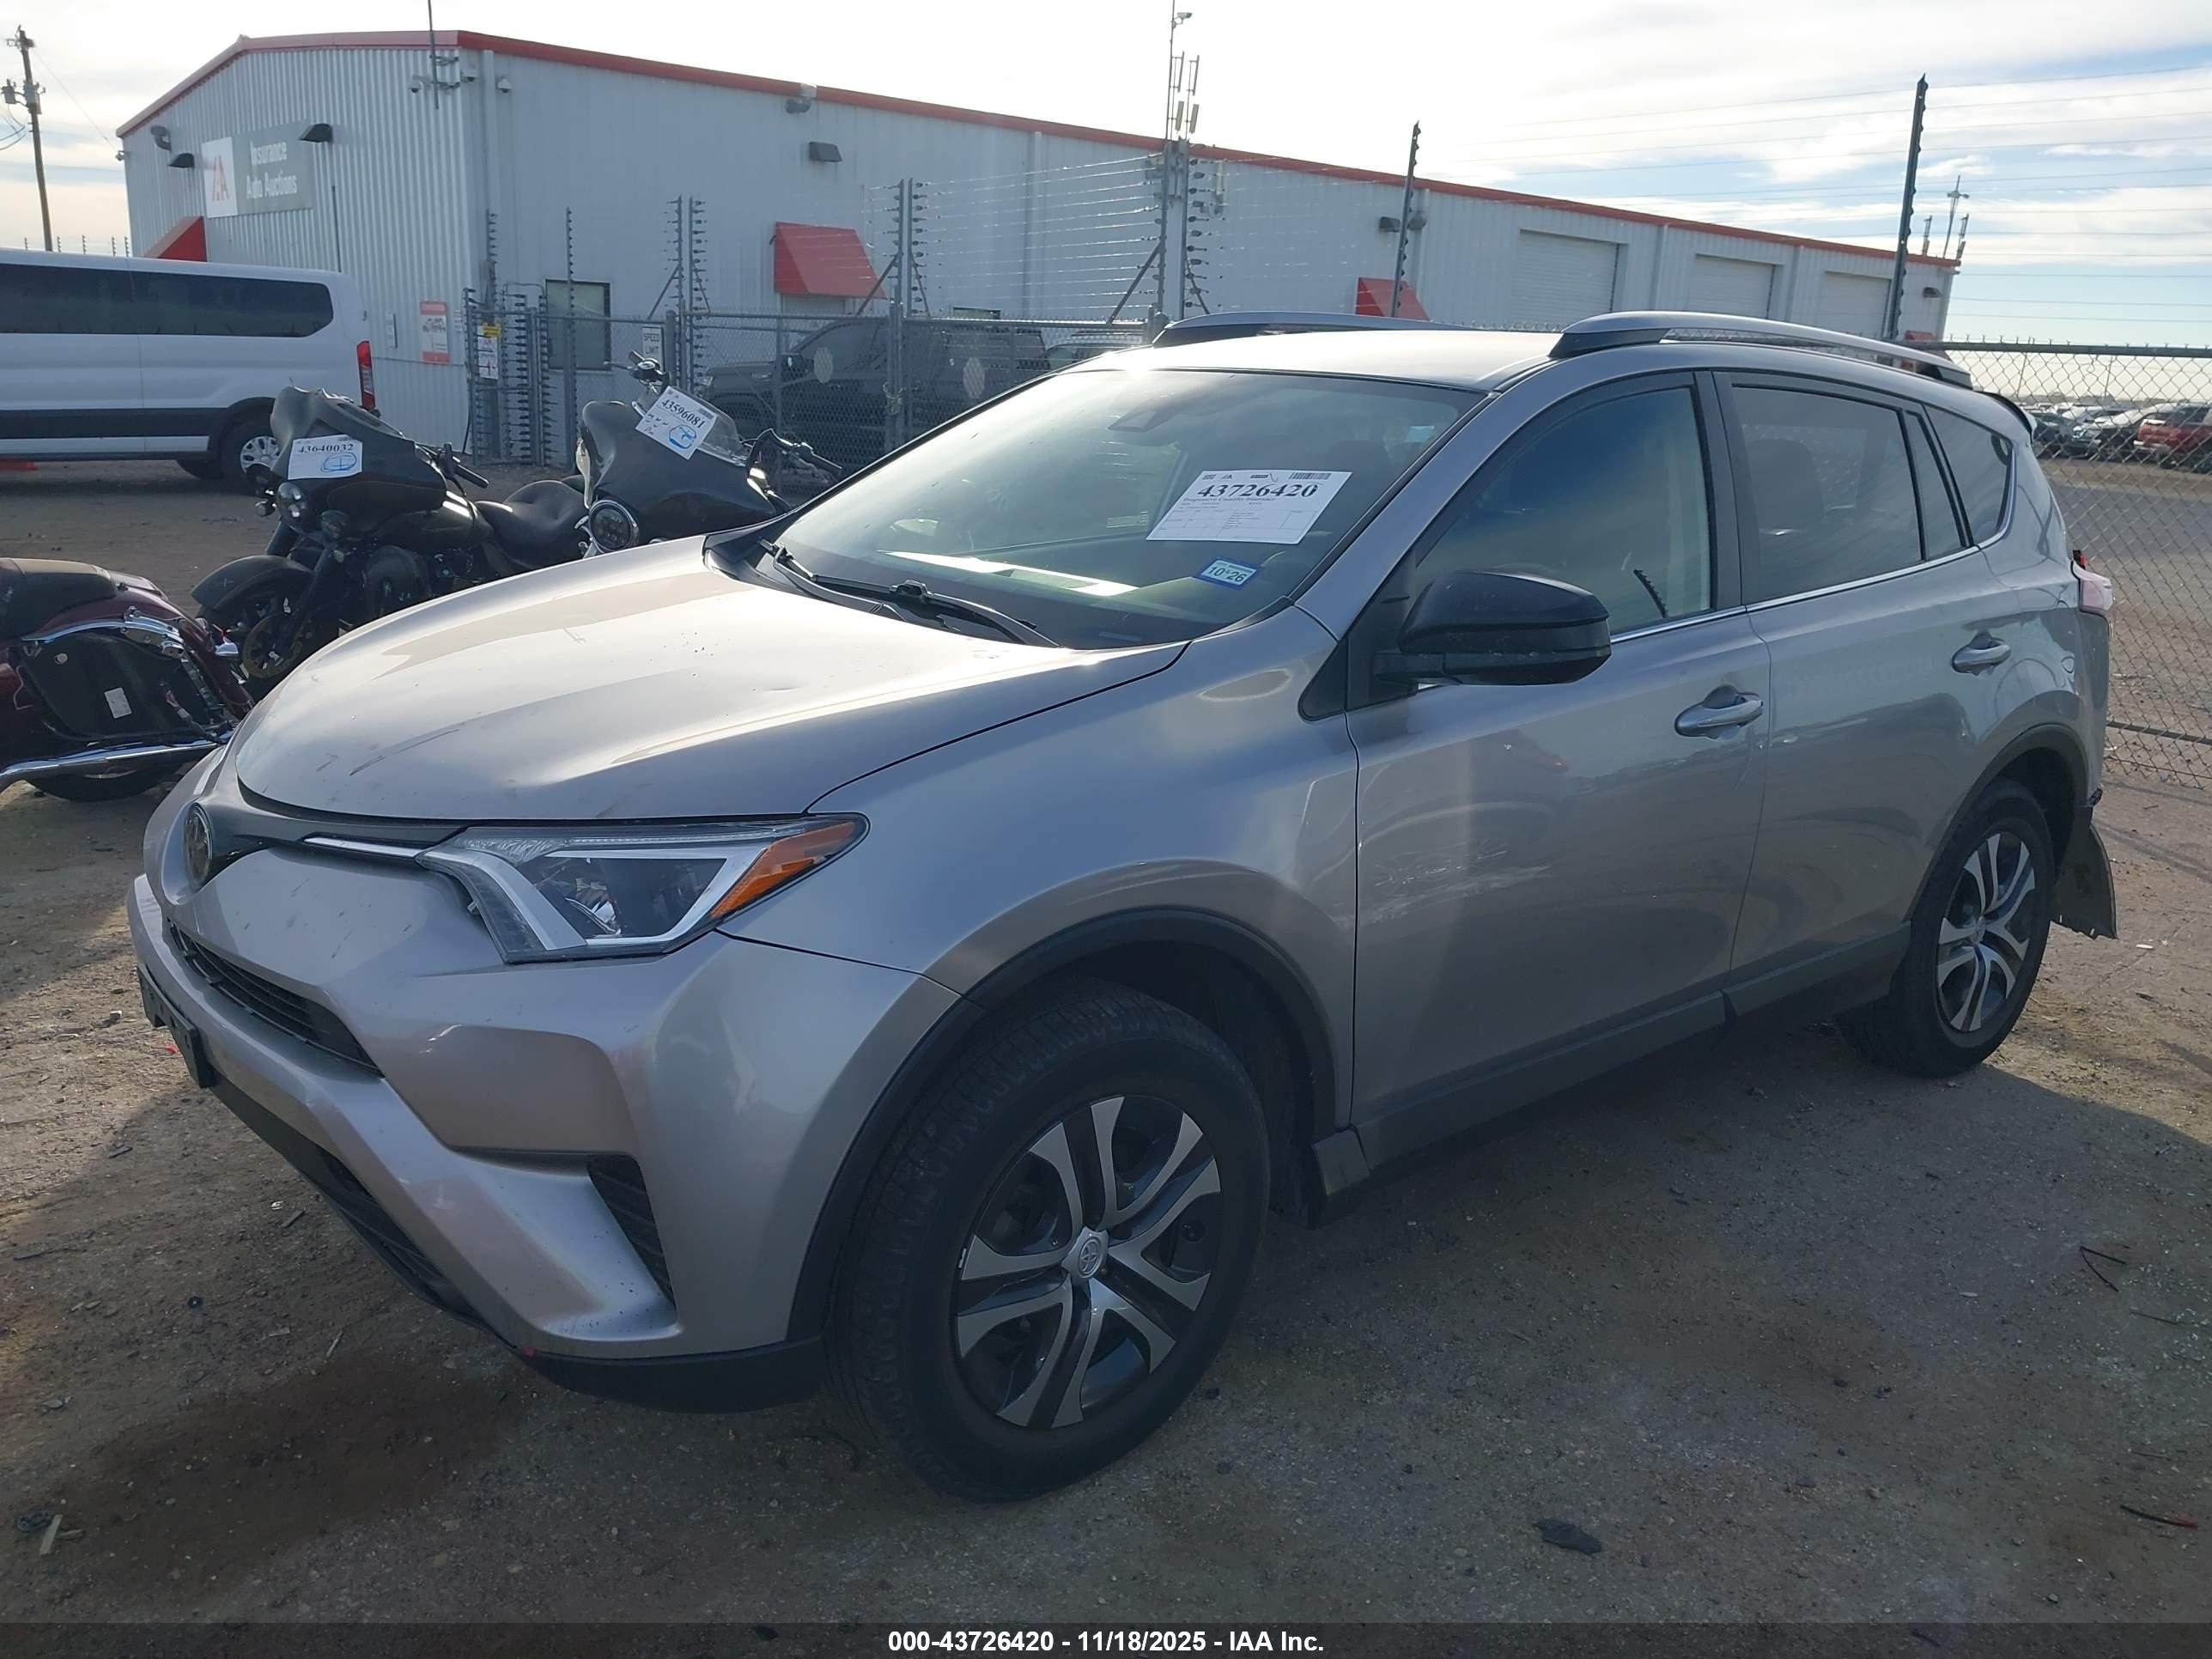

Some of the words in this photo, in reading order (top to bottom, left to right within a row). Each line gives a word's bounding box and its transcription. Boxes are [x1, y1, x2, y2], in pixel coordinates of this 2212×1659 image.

[250, 141, 288, 166] Insurance
[246, 174, 263, 198] Auto
[264, 170, 298, 198] Auctions
[643, 332, 659, 342] SPEED
[645, 345, 659, 354] LIMIT
[661, 398, 706, 428] 43596081
[297, 443, 354, 453] 43640032
[1197, 483, 1318, 497] 43726420
[1208, 566, 1226, 576] 10
[1226, 571, 1248, 582] 26
